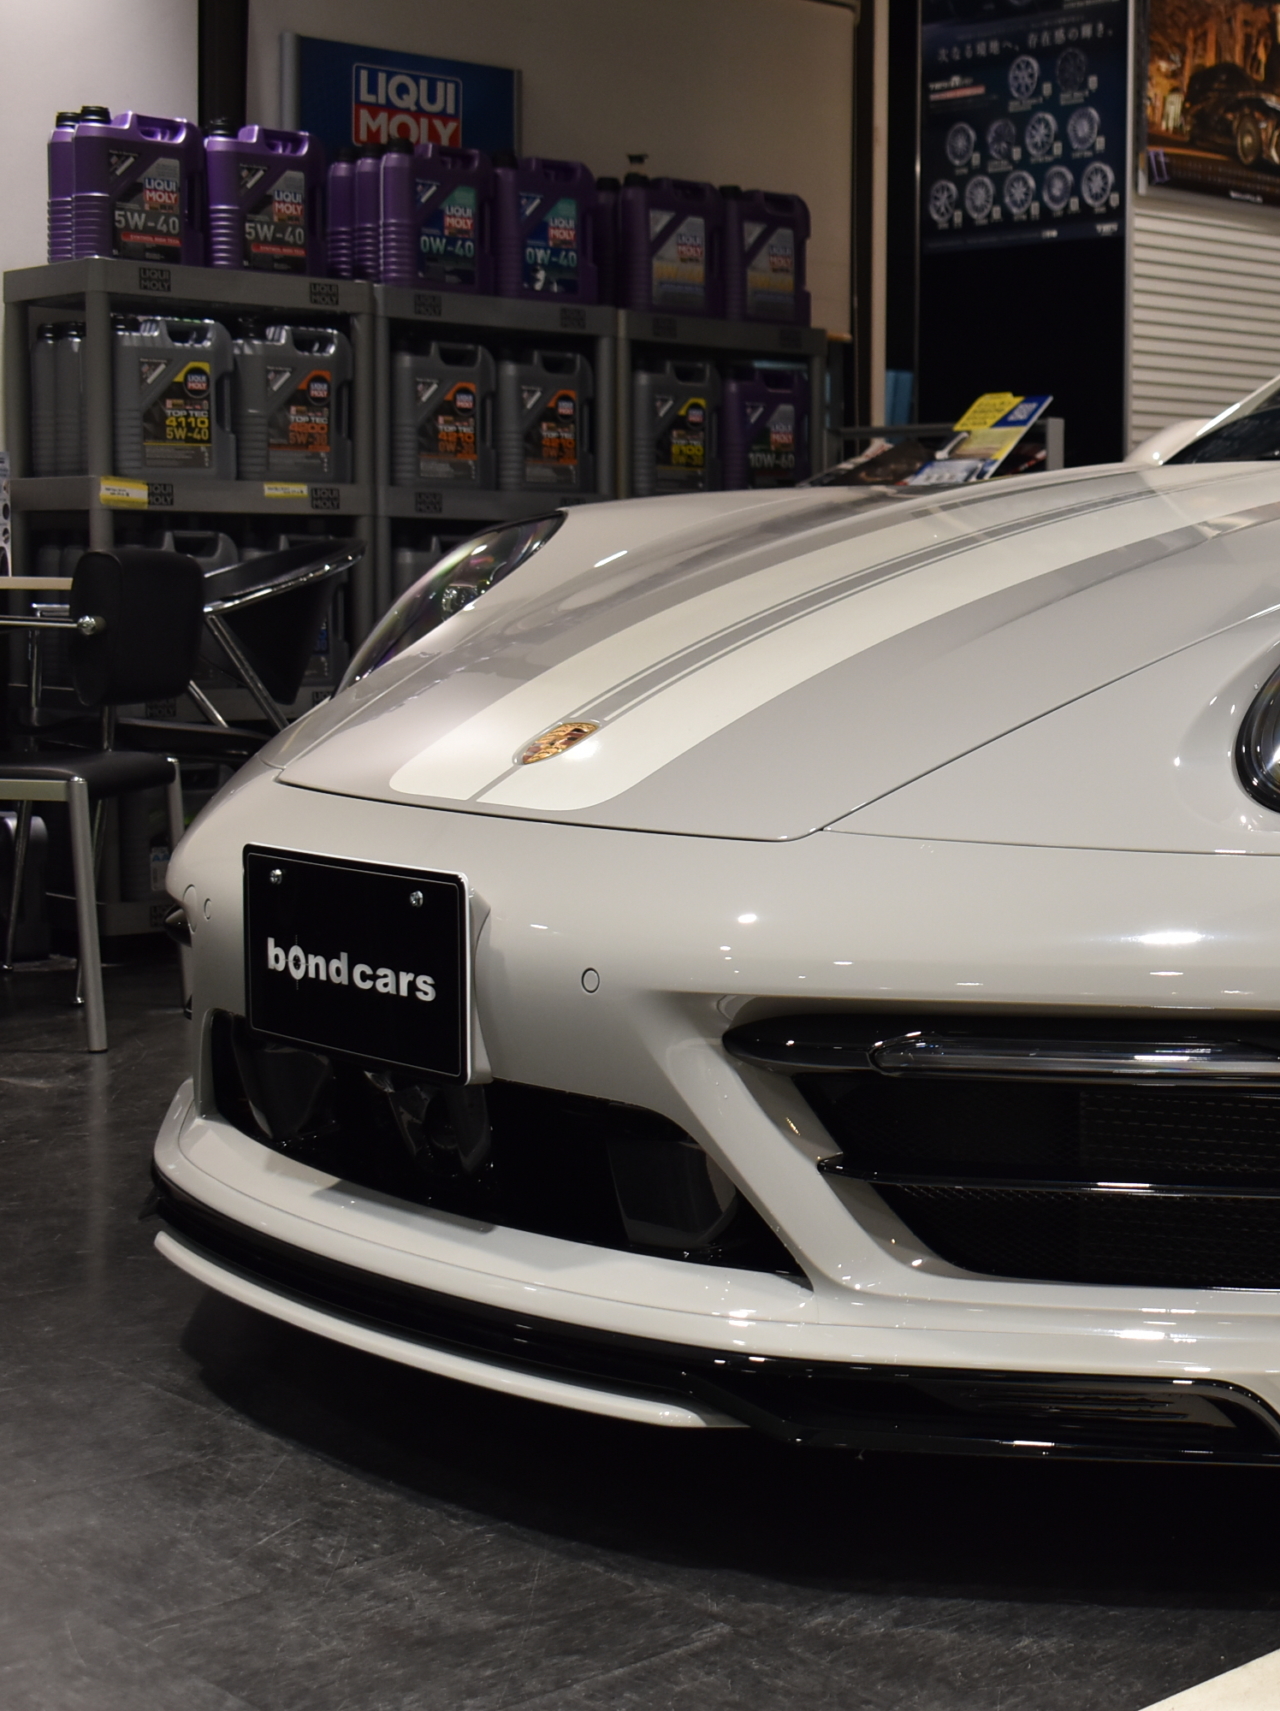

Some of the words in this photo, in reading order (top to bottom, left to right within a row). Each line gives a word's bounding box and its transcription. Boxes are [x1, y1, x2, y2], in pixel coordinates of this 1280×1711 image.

[359, 69, 456, 115] LIQUI
[359, 108, 458, 147] MOLY
[145, 178, 177, 192] LIQUI
[145, 190, 178, 204] MOLY
[274, 190, 302, 204] LIQUI
[275, 202, 304, 215] MOLY
[445, 205, 473, 218] LIQUI
[114, 210, 180, 235] 5W-40
[446, 216, 474, 230] MOLY
[244, 222, 305, 245] 5W-40
[550, 228, 576, 240] MOLY
[420, 235, 475, 258] 0W-40
[525, 247, 577, 268] 0W-40
[140, 268, 170, 281] LIQUI
[140, 279, 171, 291] MOLY
[310, 283, 338, 295] LIQUI
[310, 293, 339, 305] MOLY
[165, 417, 209, 428] 4110
[166, 427, 209, 440] 5W-40
[748, 452, 795, 468] 10W-60
[149, 484, 173, 494] IQUI
[312, 489, 339, 499] LIQUI
[312, 498, 340, 509] MOLY
